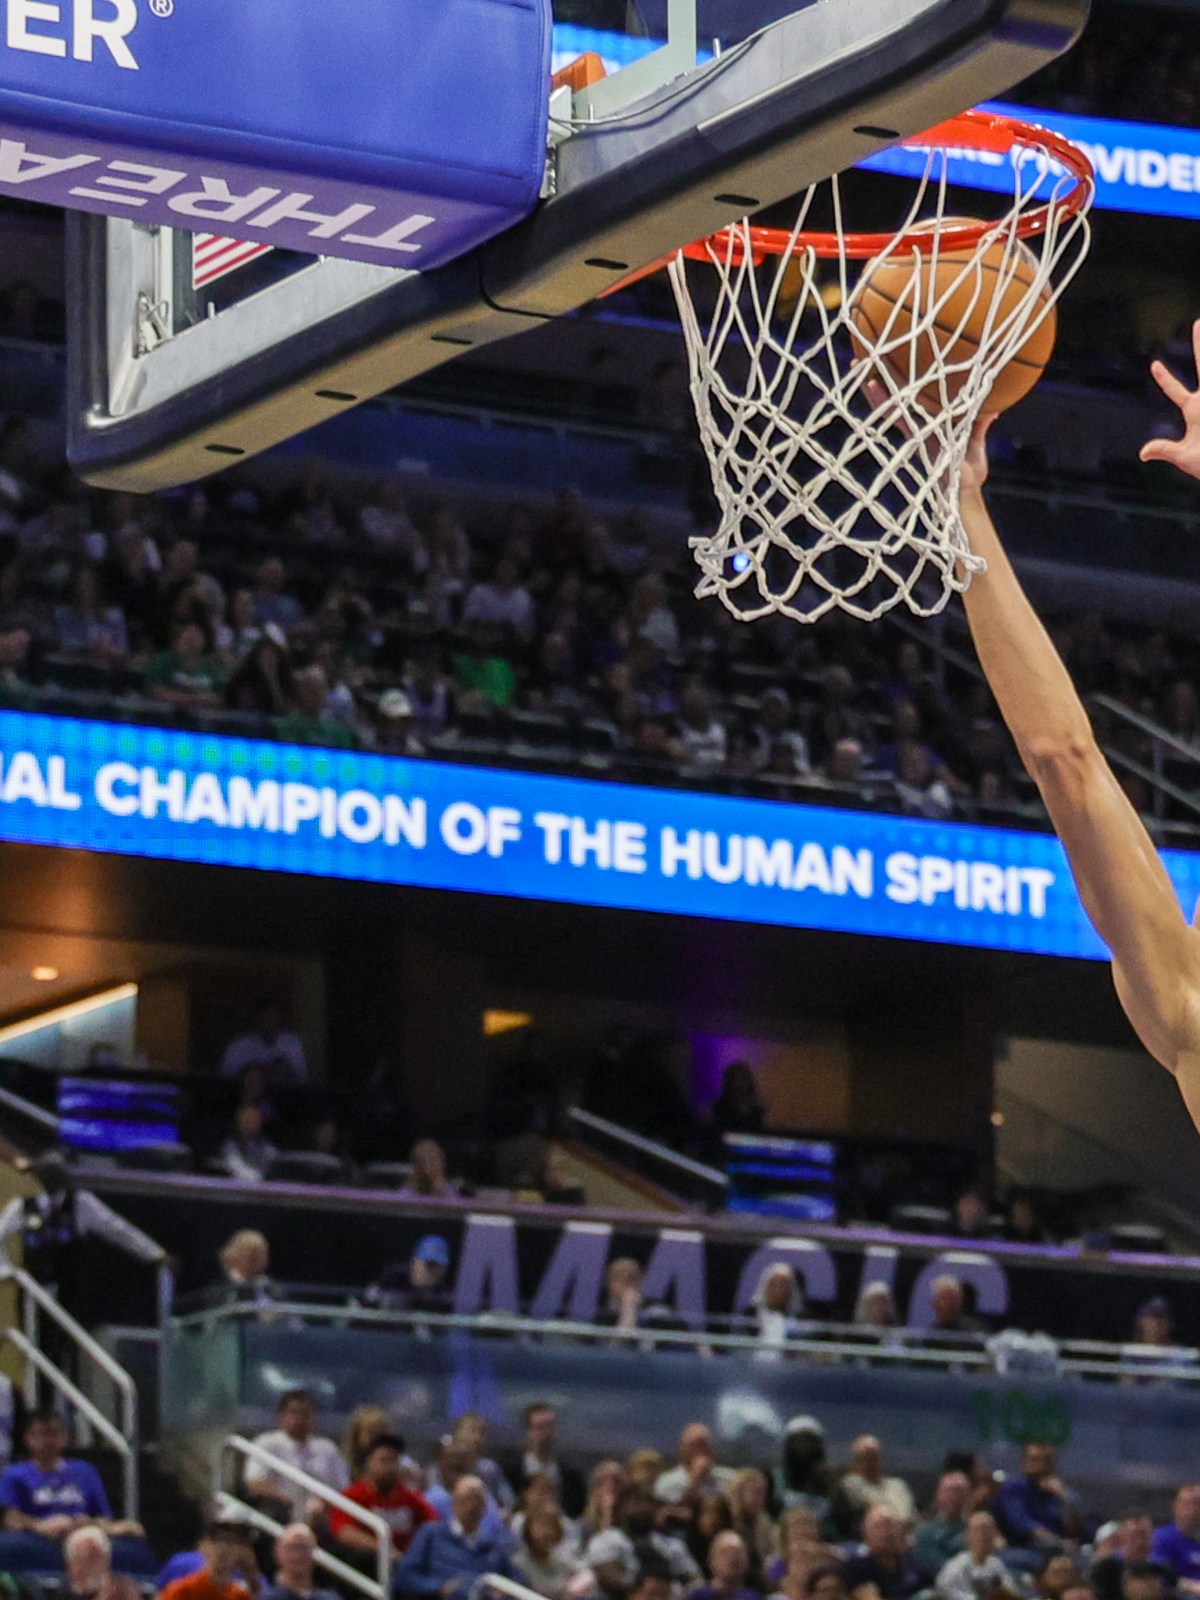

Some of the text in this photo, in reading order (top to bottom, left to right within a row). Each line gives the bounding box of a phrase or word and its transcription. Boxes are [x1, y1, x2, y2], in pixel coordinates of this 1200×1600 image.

[0, 750, 1056, 919] AL CHAMPION OF THE HUMAN SPIRIT
